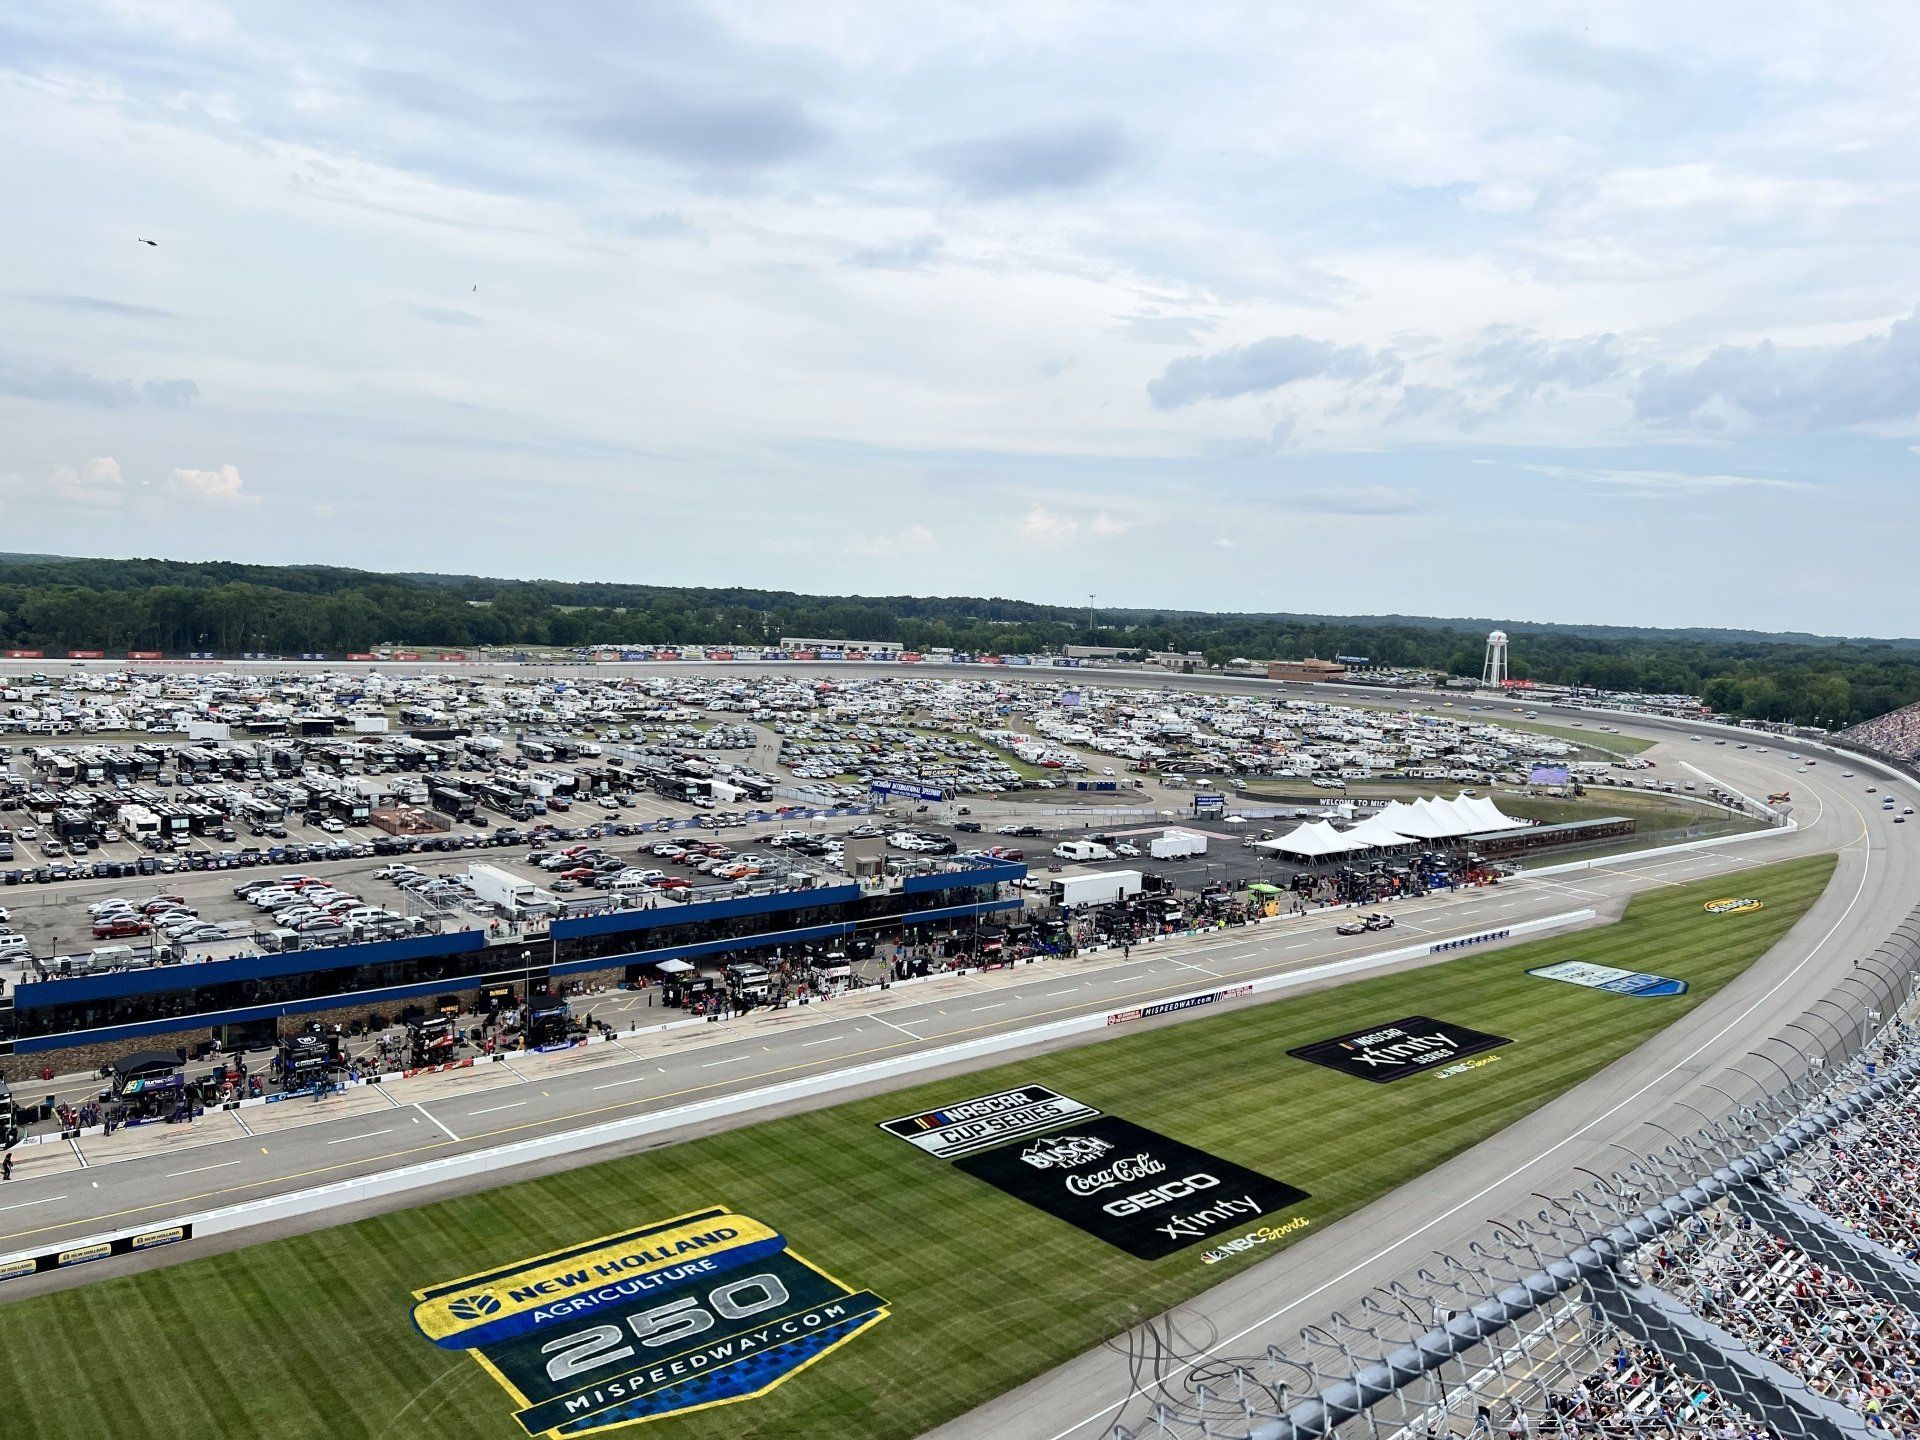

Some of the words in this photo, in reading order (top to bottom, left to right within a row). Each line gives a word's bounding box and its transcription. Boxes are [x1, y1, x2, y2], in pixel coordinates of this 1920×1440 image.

[628, 652, 645, 660] xfinity
[892, 783, 922, 794] INTERNATIONAL
[921, 787, 942, 797] SPEEDWAY
[1319, 798, 1355, 806] WELCOME
[1357, 799, 1368, 807] TO
[1144, 996, 1212, 1016] MISPEEDWAY.com
[1351, 1032, 1459, 1067] xfinity
[1353, 1028, 1407, 1047] NASCAR
[1412, 1048, 1455, 1064] SERIES
[944, 1092, 1033, 1123] NASCAR
[939, 1121, 989, 1145] CUP
[990, 1103, 1063, 1133] SERIES
[1020, 1136, 1115, 1170] BUSCH
[1058, 1150, 1105, 1169] LIGHT
[1065, 1152, 1166, 1196] Coca-Cola
[1103, 1173, 1221, 1217] GEICO
[1156, 1195, 1262, 1240] xfinity
[157, 1230, 180, 1240] HOLLAND
[1220, 1233, 1267, 1256] NBC
[1258, 1215, 1310, 1242] Sports
[70, 1254, 100, 1264] AGRICULTURE
[84, 1246, 108, 1256] HOLLAND
[510, 1267, 590, 1304] NEW
[594, 1227, 740, 1277] HOLLAND
[7, 1262, 33, 1272] HOLLAND
[532, 1259, 718, 1324] AGRICULTURE
[541, 1273, 791, 1382] 250
[564, 1304, 846, 1414] MISPEEDWAY.COM
